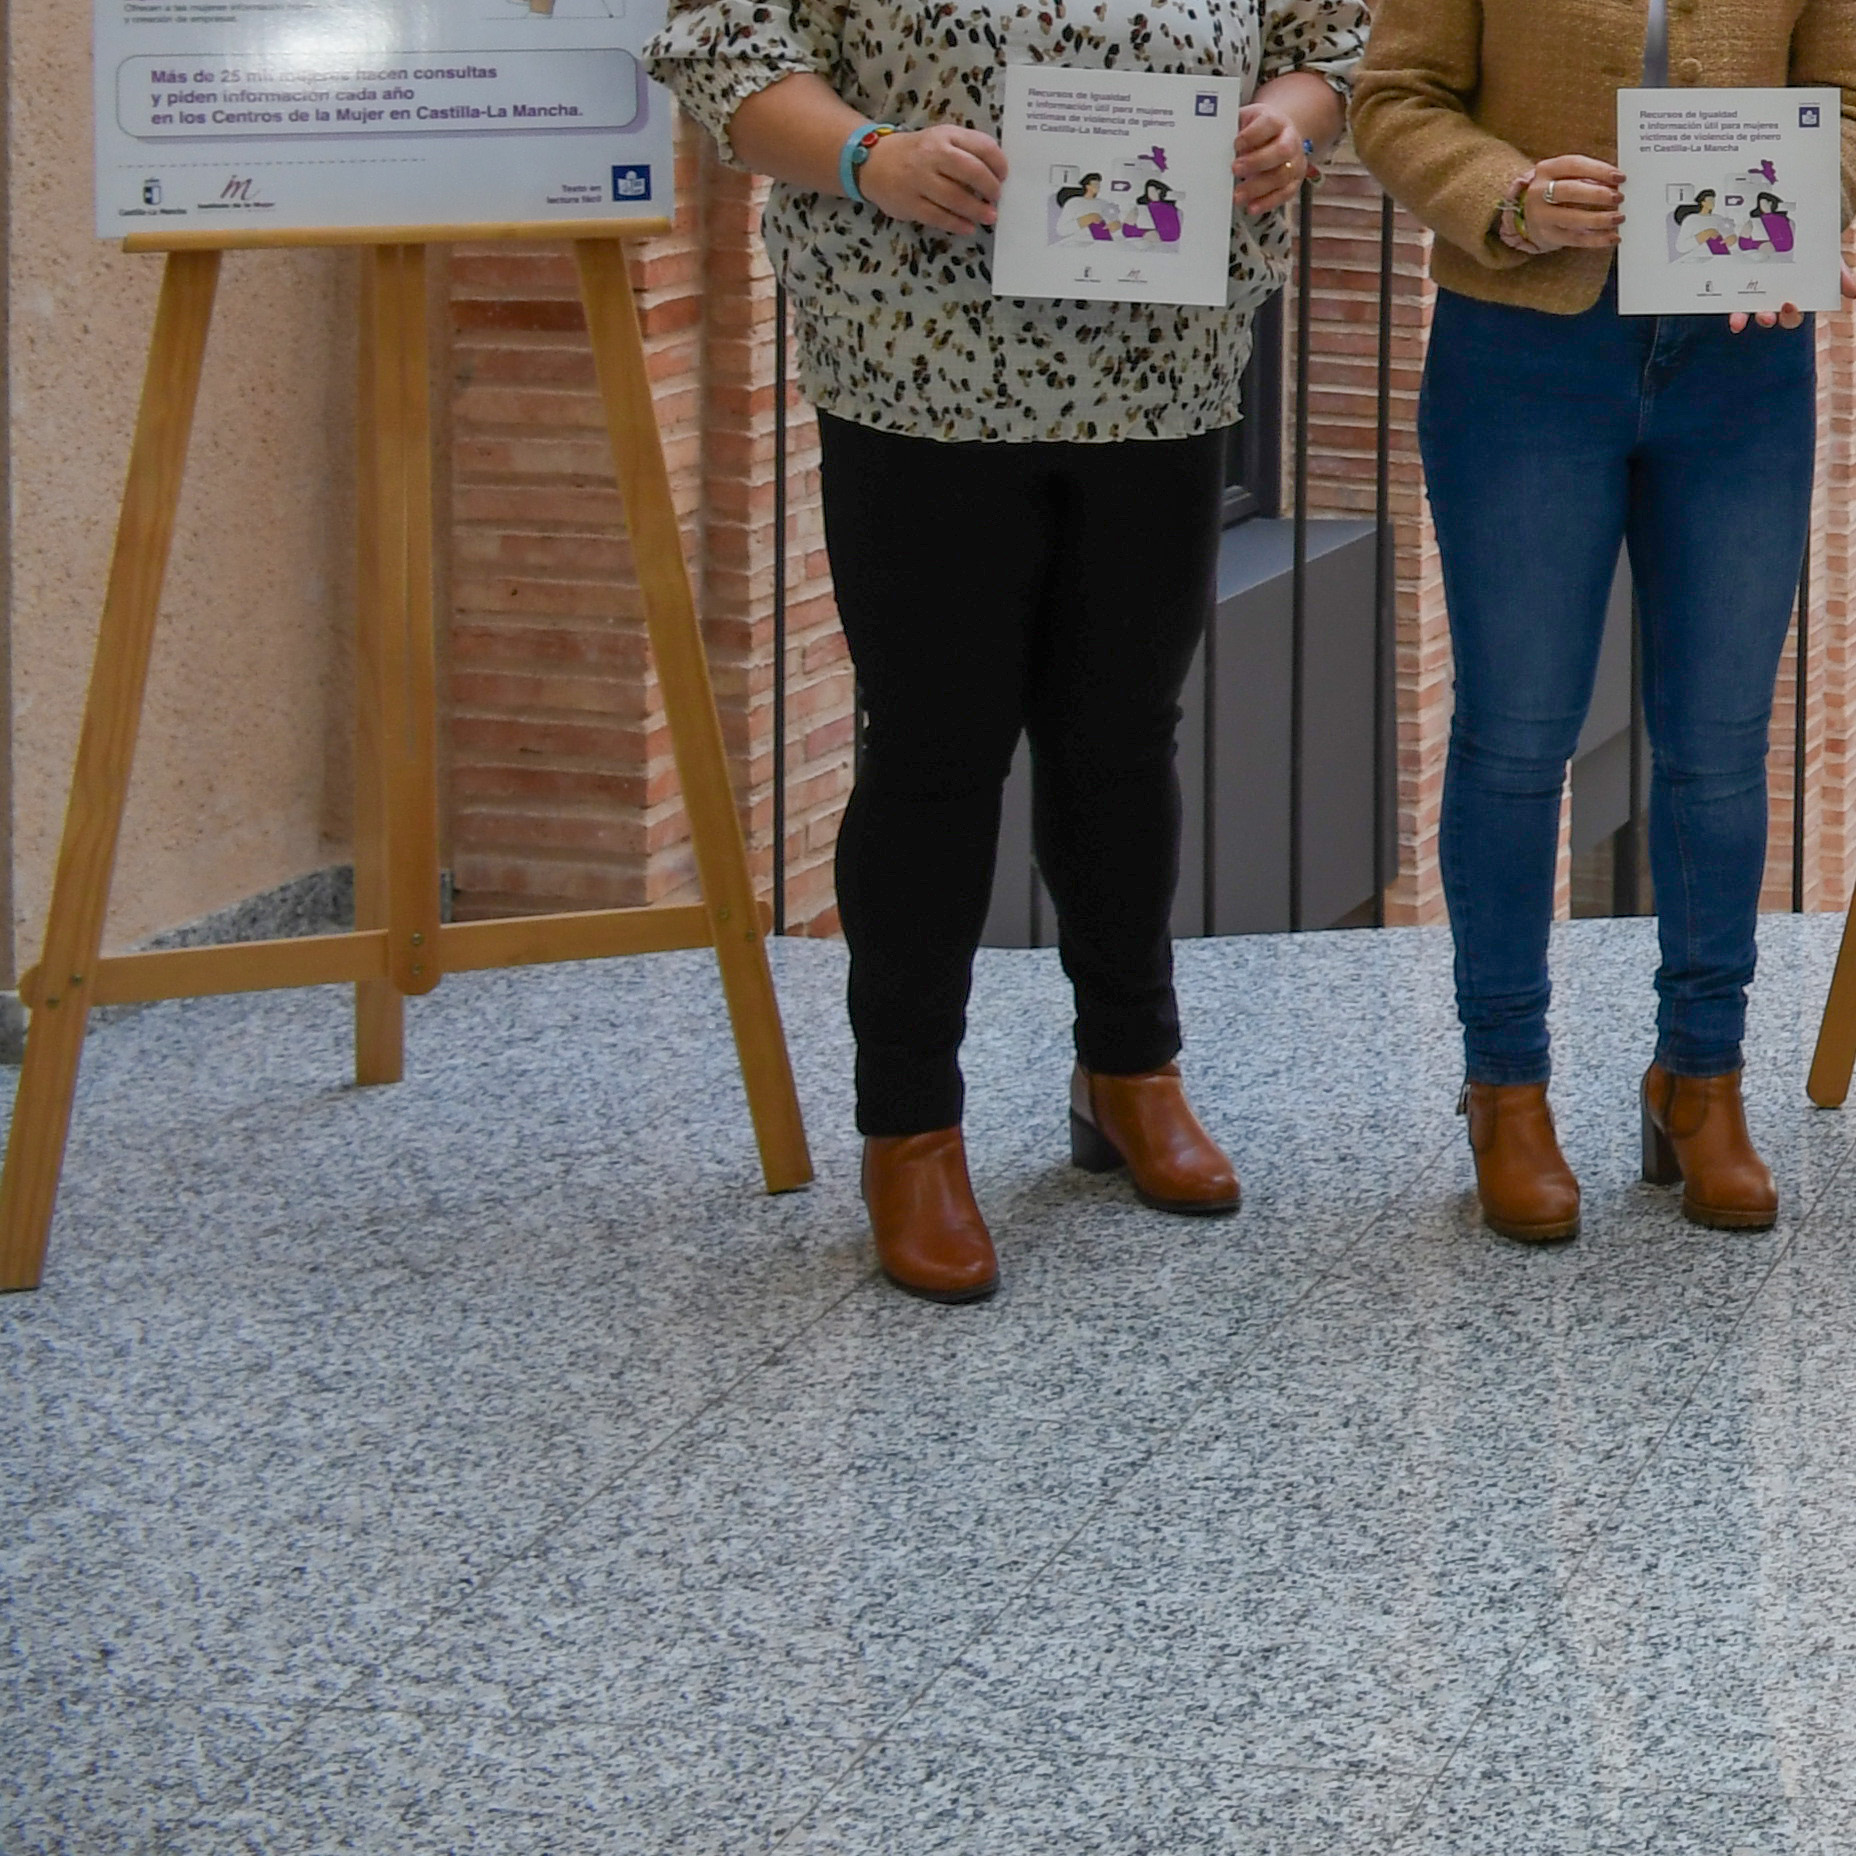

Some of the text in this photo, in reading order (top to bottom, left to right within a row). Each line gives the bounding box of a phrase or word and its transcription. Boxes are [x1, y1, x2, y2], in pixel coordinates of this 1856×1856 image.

[150, 69, 188, 84] Más
[192, 69, 215, 84] de
[412, 65, 498, 80] consultas
[150, 93, 162, 108] y
[166, 90, 218, 108] piden
[334, 87, 378, 102] cada
[381, 86, 415, 101] año
[150, 103, 584, 125] en los Centros de la Mujer en Castilla-La Mancha.
